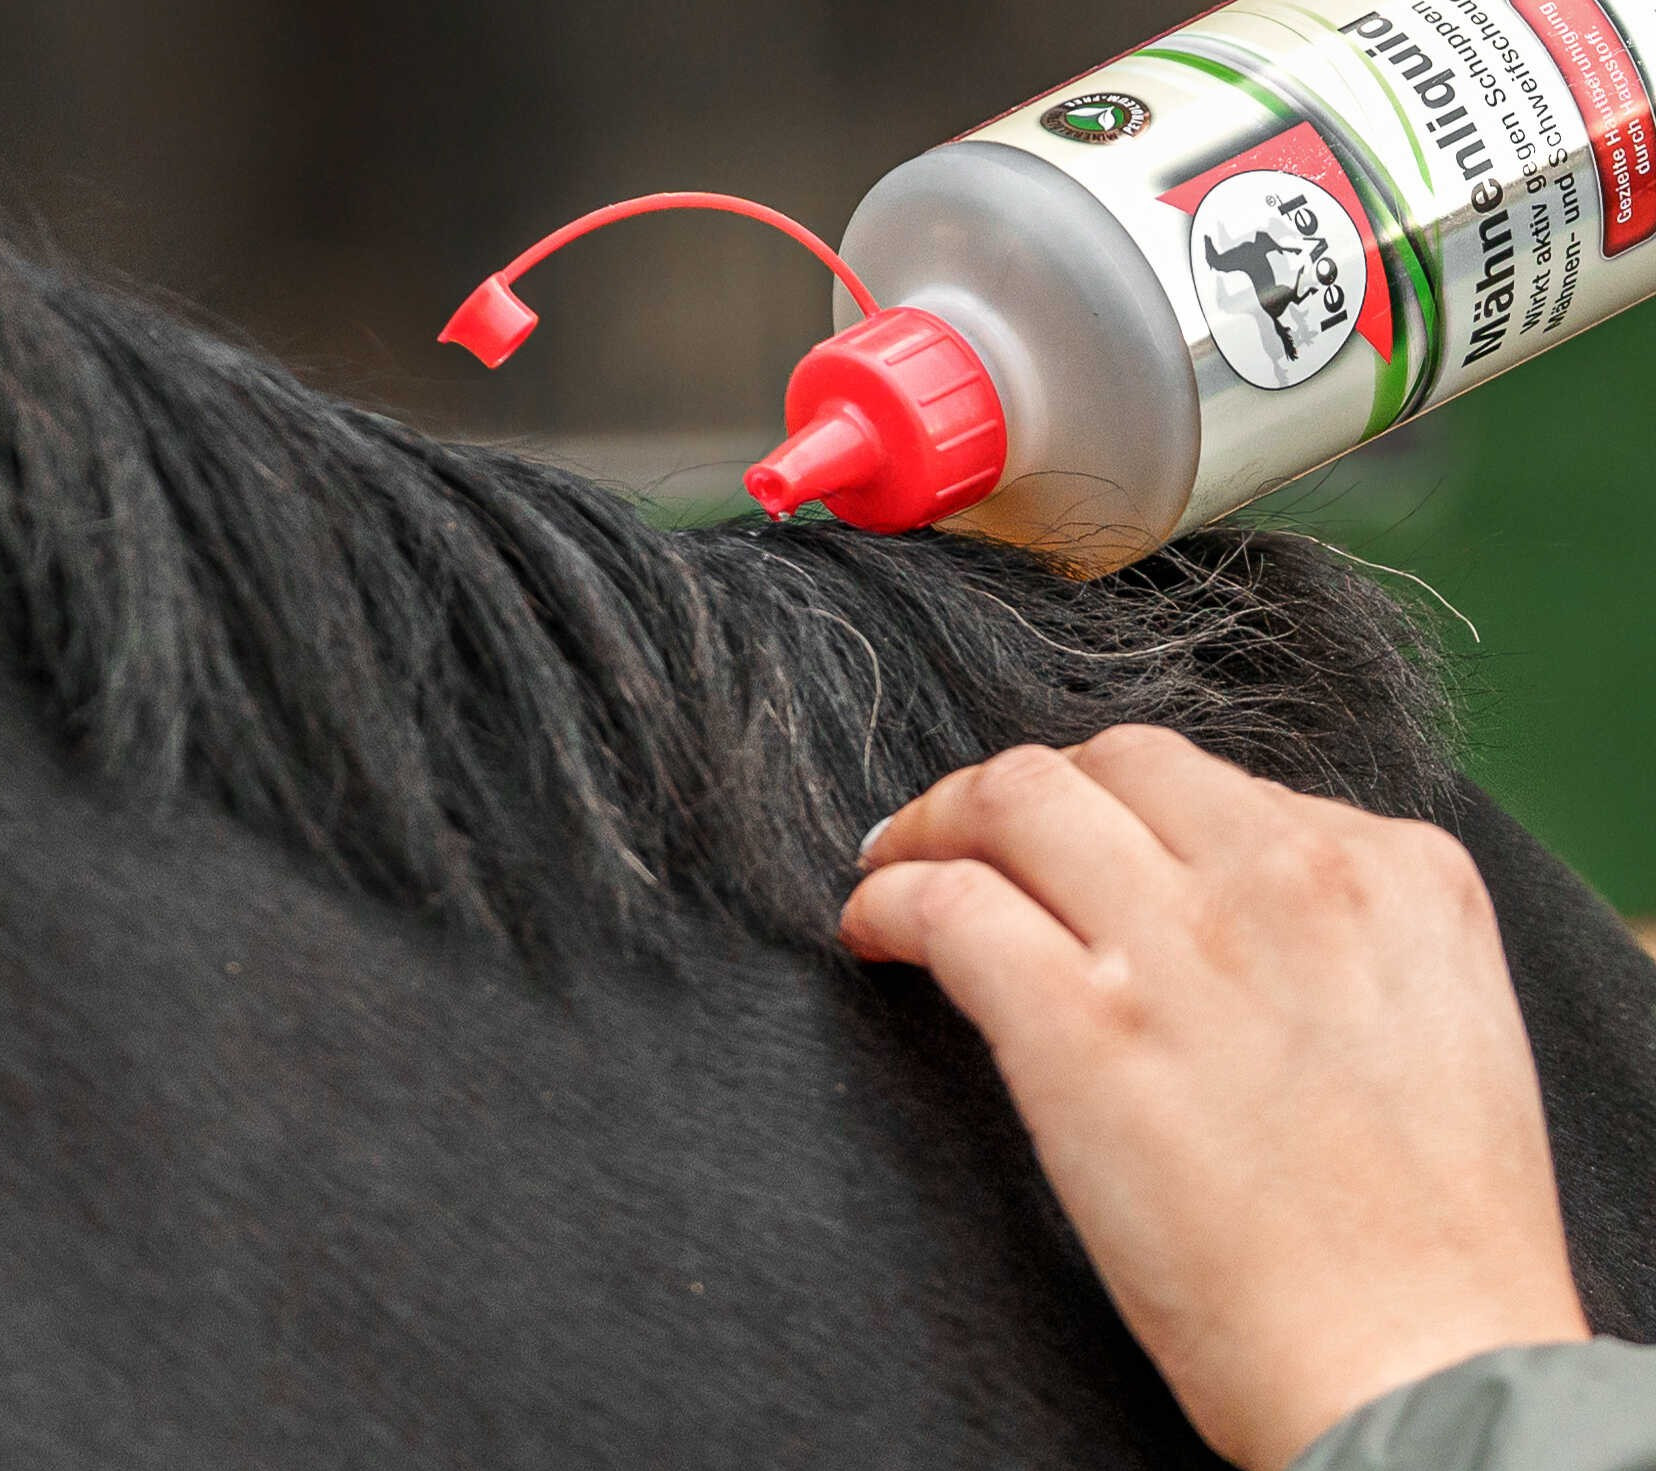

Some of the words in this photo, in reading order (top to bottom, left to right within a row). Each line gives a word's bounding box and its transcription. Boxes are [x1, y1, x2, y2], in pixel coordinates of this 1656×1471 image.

[1539, 1, 1620, 144] Hautberuhigung
[1500, 112, 1545, 193] gegen
[1627, 119, 1650, 173] durch
[1337, 10, 1513, 367] Mähnenliquid
[1553, 172, 1580, 223] und
[1607, 147, 1632, 223] Gezielte
[1532, 205, 1549, 262] aktiv
[1520, 269, 1549, 334] Wirkt
[1543, 232, 1580, 332] Mähnen-
